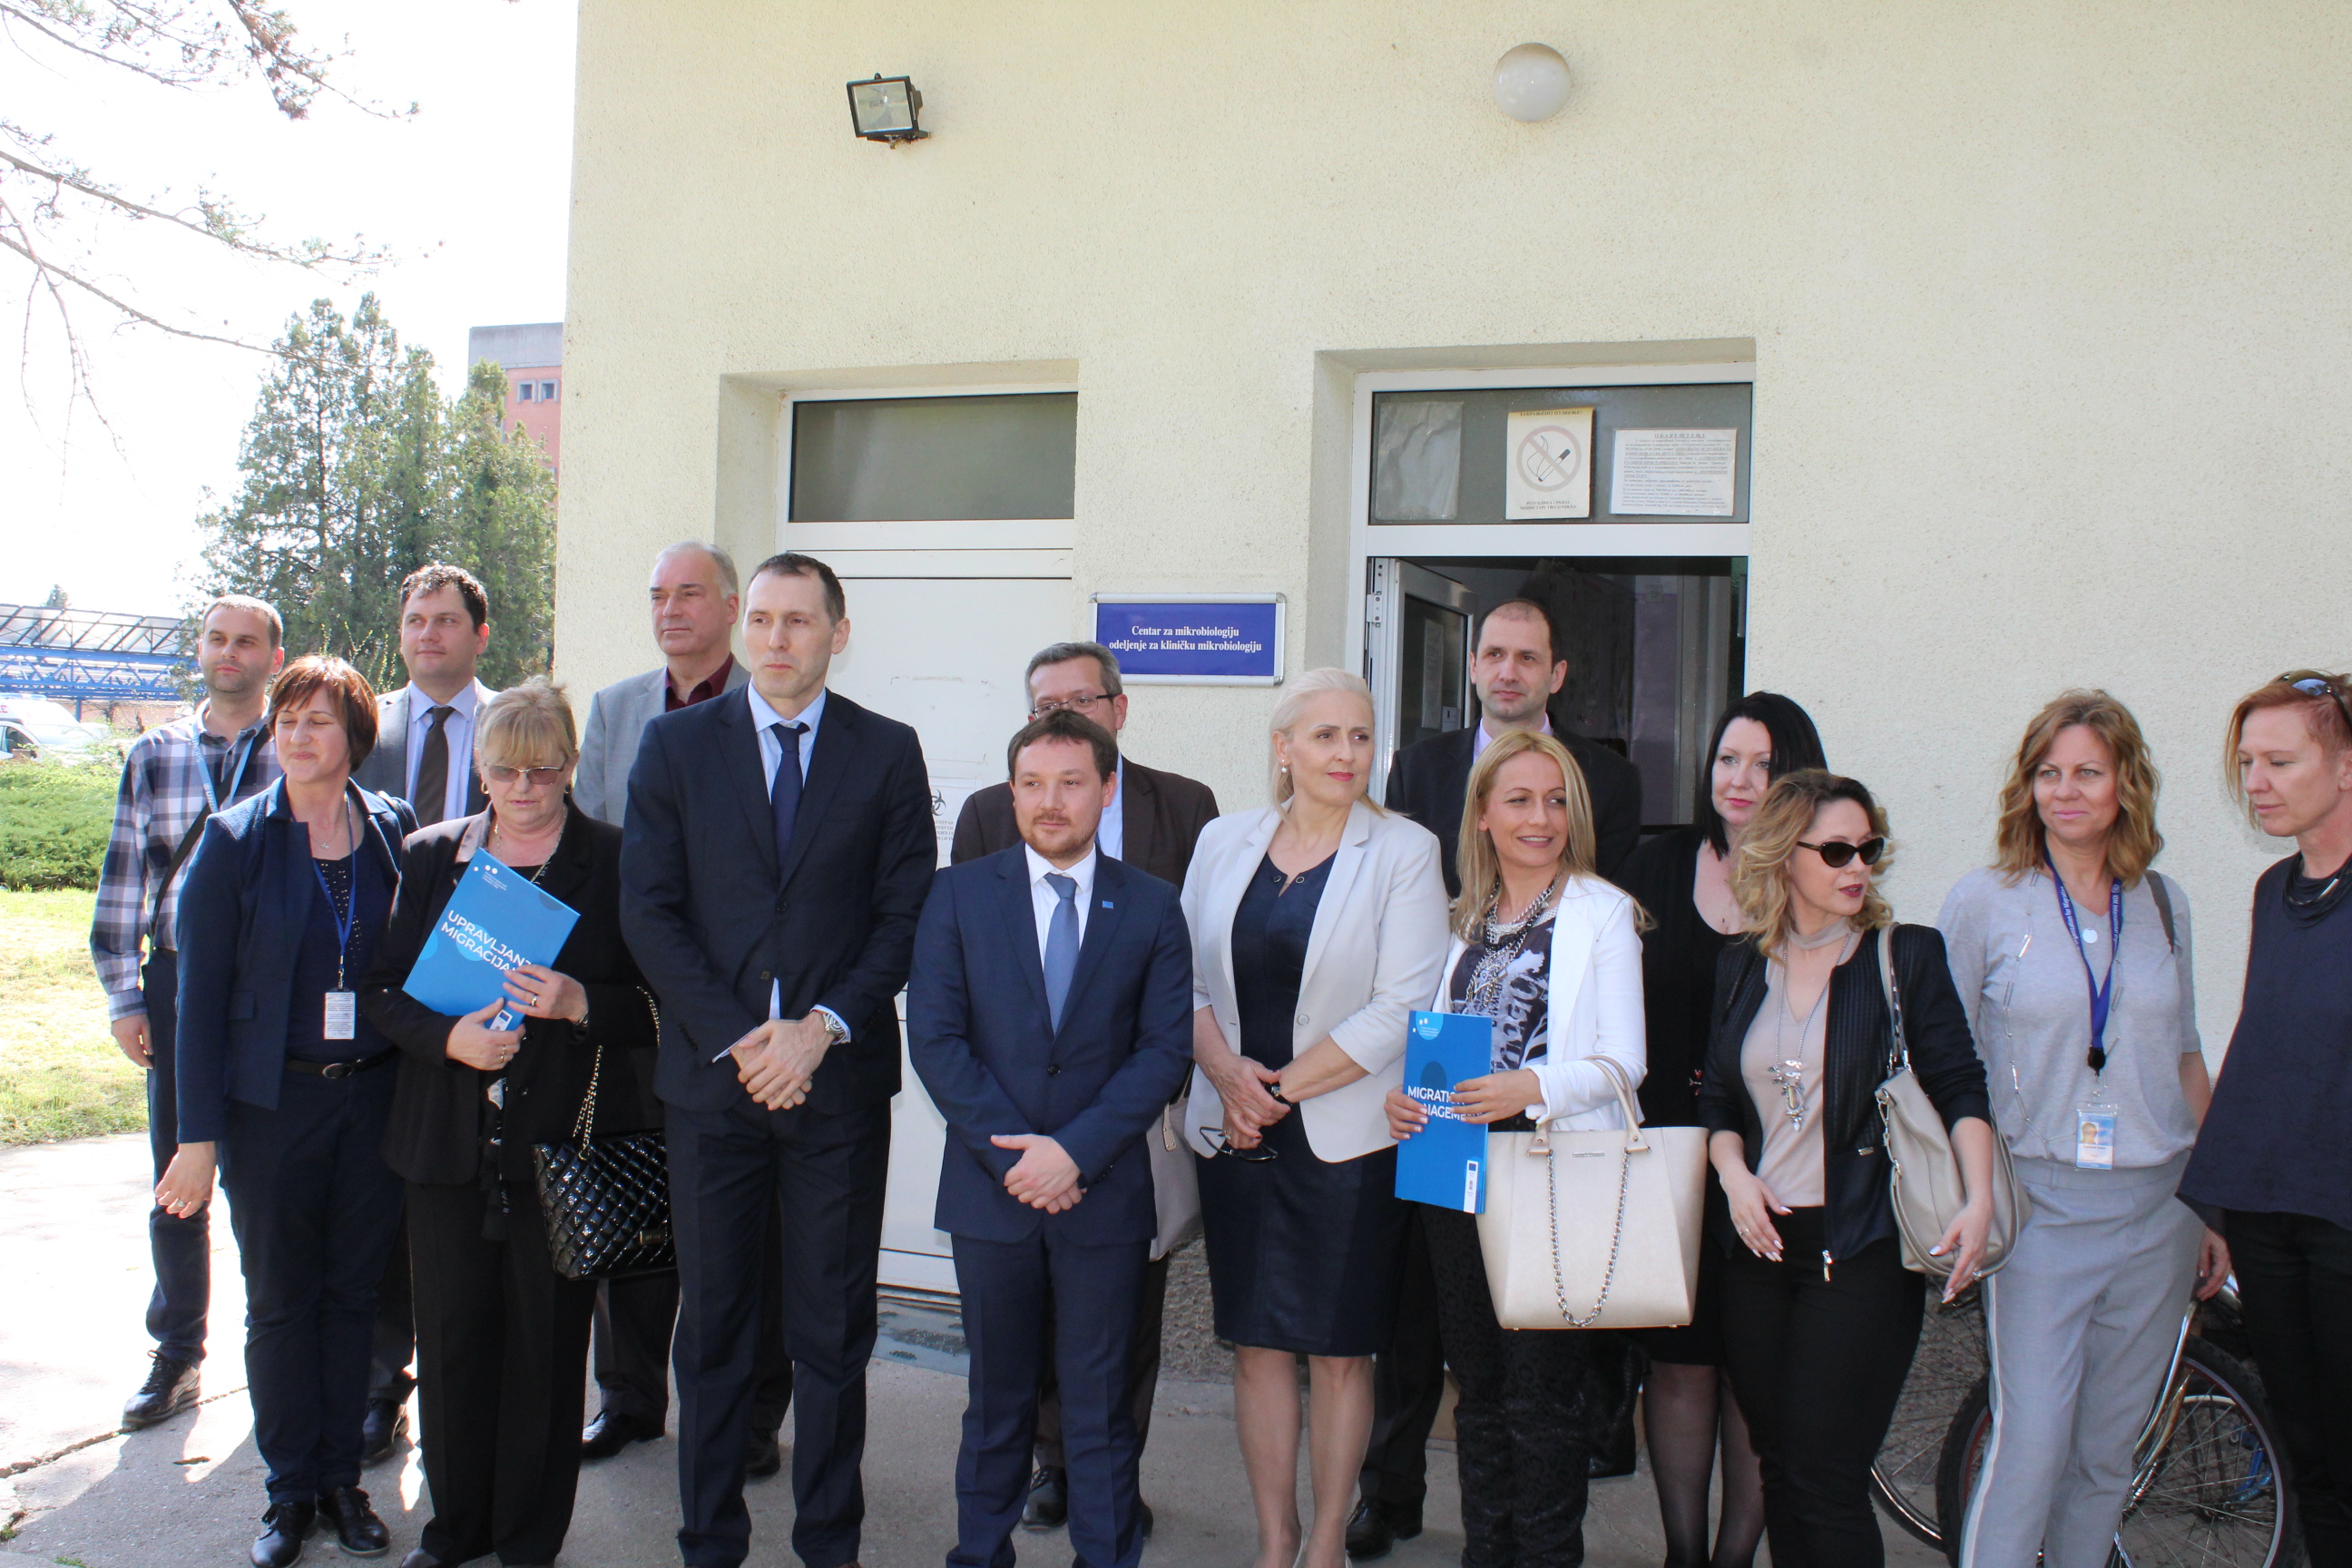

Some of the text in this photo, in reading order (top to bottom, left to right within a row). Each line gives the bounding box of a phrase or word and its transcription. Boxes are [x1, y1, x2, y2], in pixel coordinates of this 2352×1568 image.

[1132, 625, 1240, 639] Centar za mikrobiologiju
[1109, 639, 1262, 653] odeljenje za kliničku mikrobiologiju
[191, 736, 203, 763] UNOPS
[2112, 894, 2120, 905] IOM
[2112, 904, 2120, 934] International
[441, 921, 517, 972] MIGRACIJA
[1407, 1085, 1464, 1105] MIGRATI
